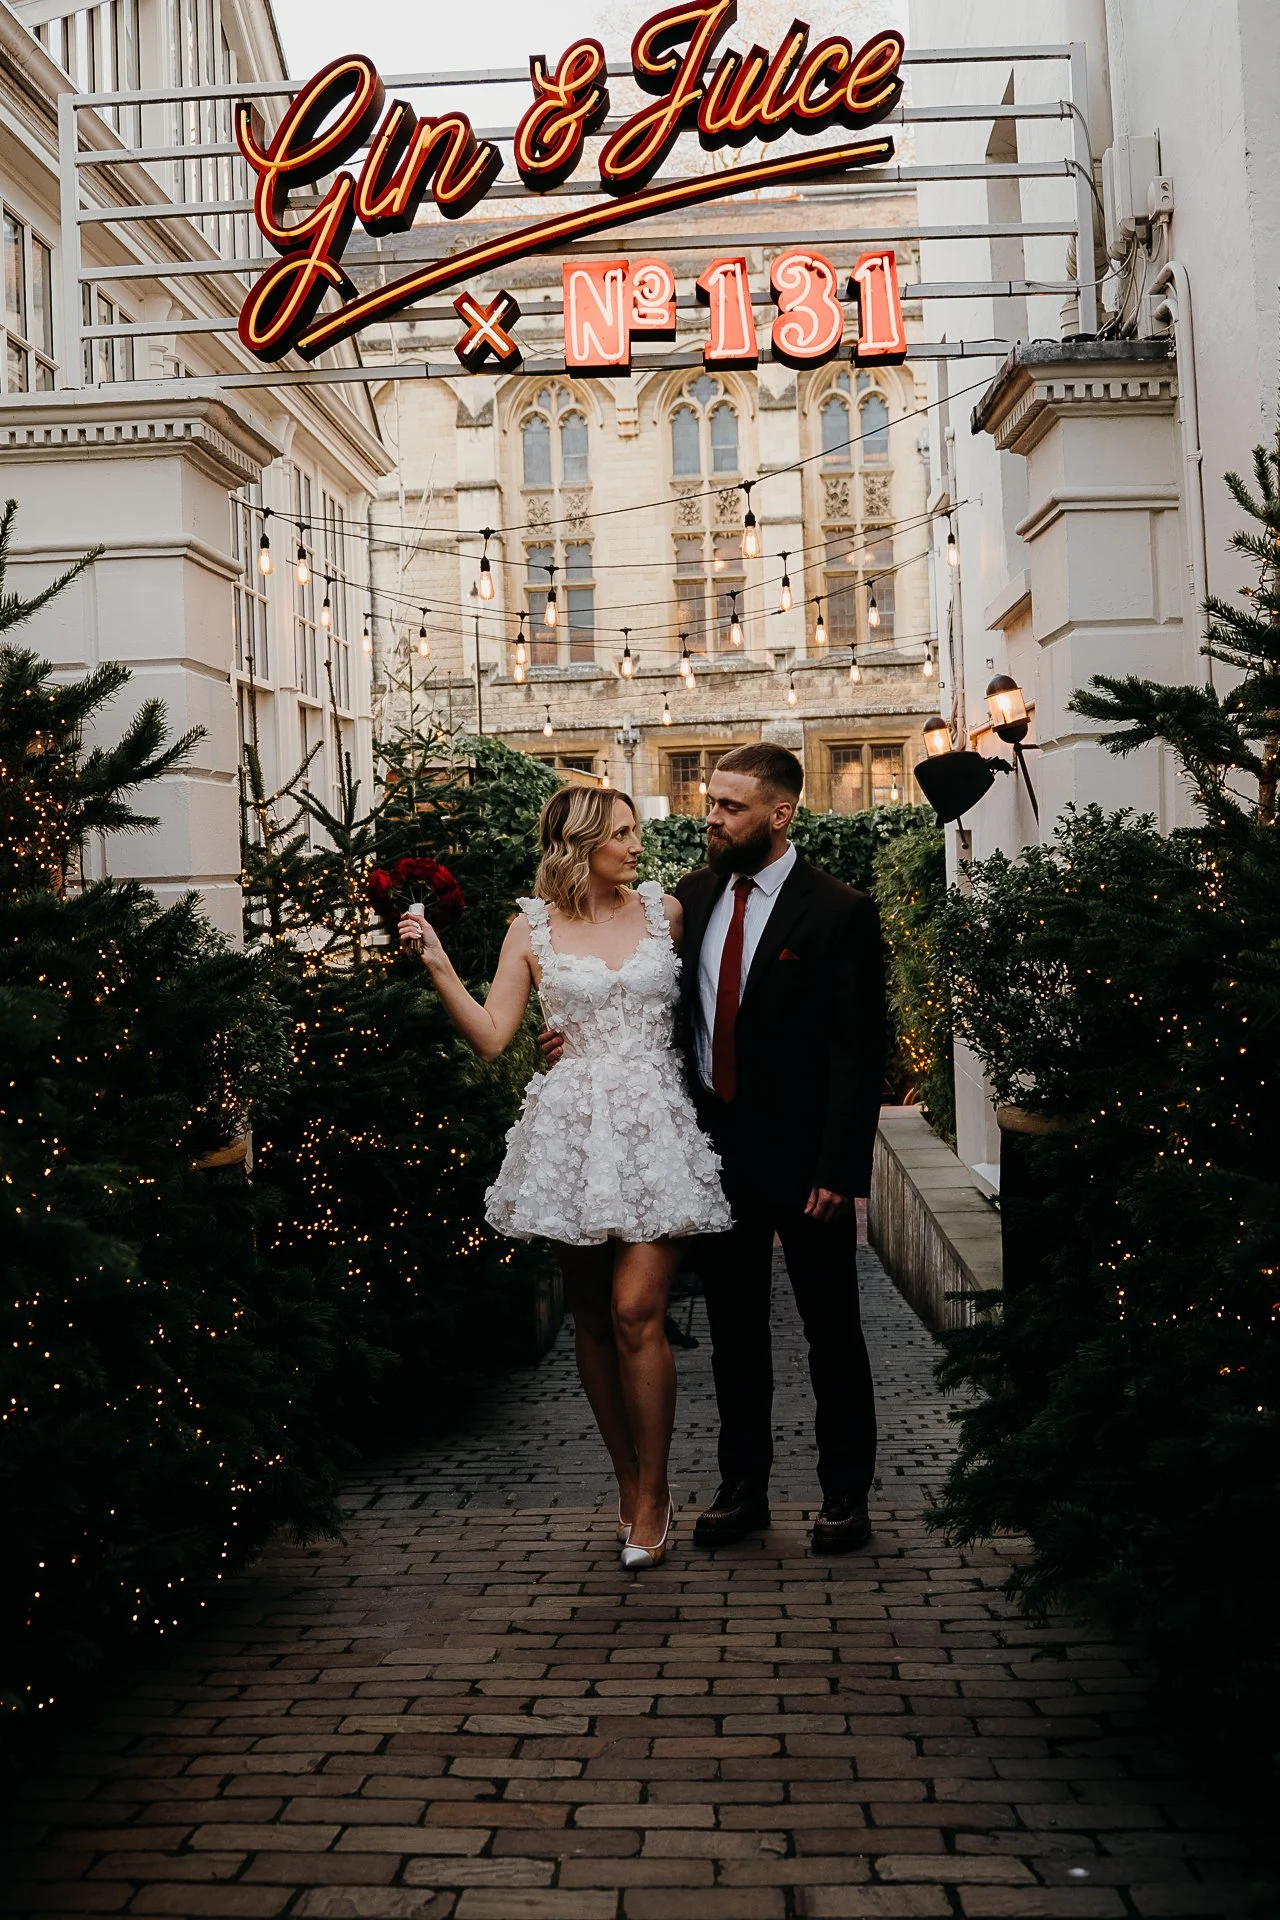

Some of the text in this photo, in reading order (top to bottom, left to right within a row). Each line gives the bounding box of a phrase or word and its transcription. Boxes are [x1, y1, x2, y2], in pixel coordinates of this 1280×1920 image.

[235, 0, 905, 363] Gin & Juice
